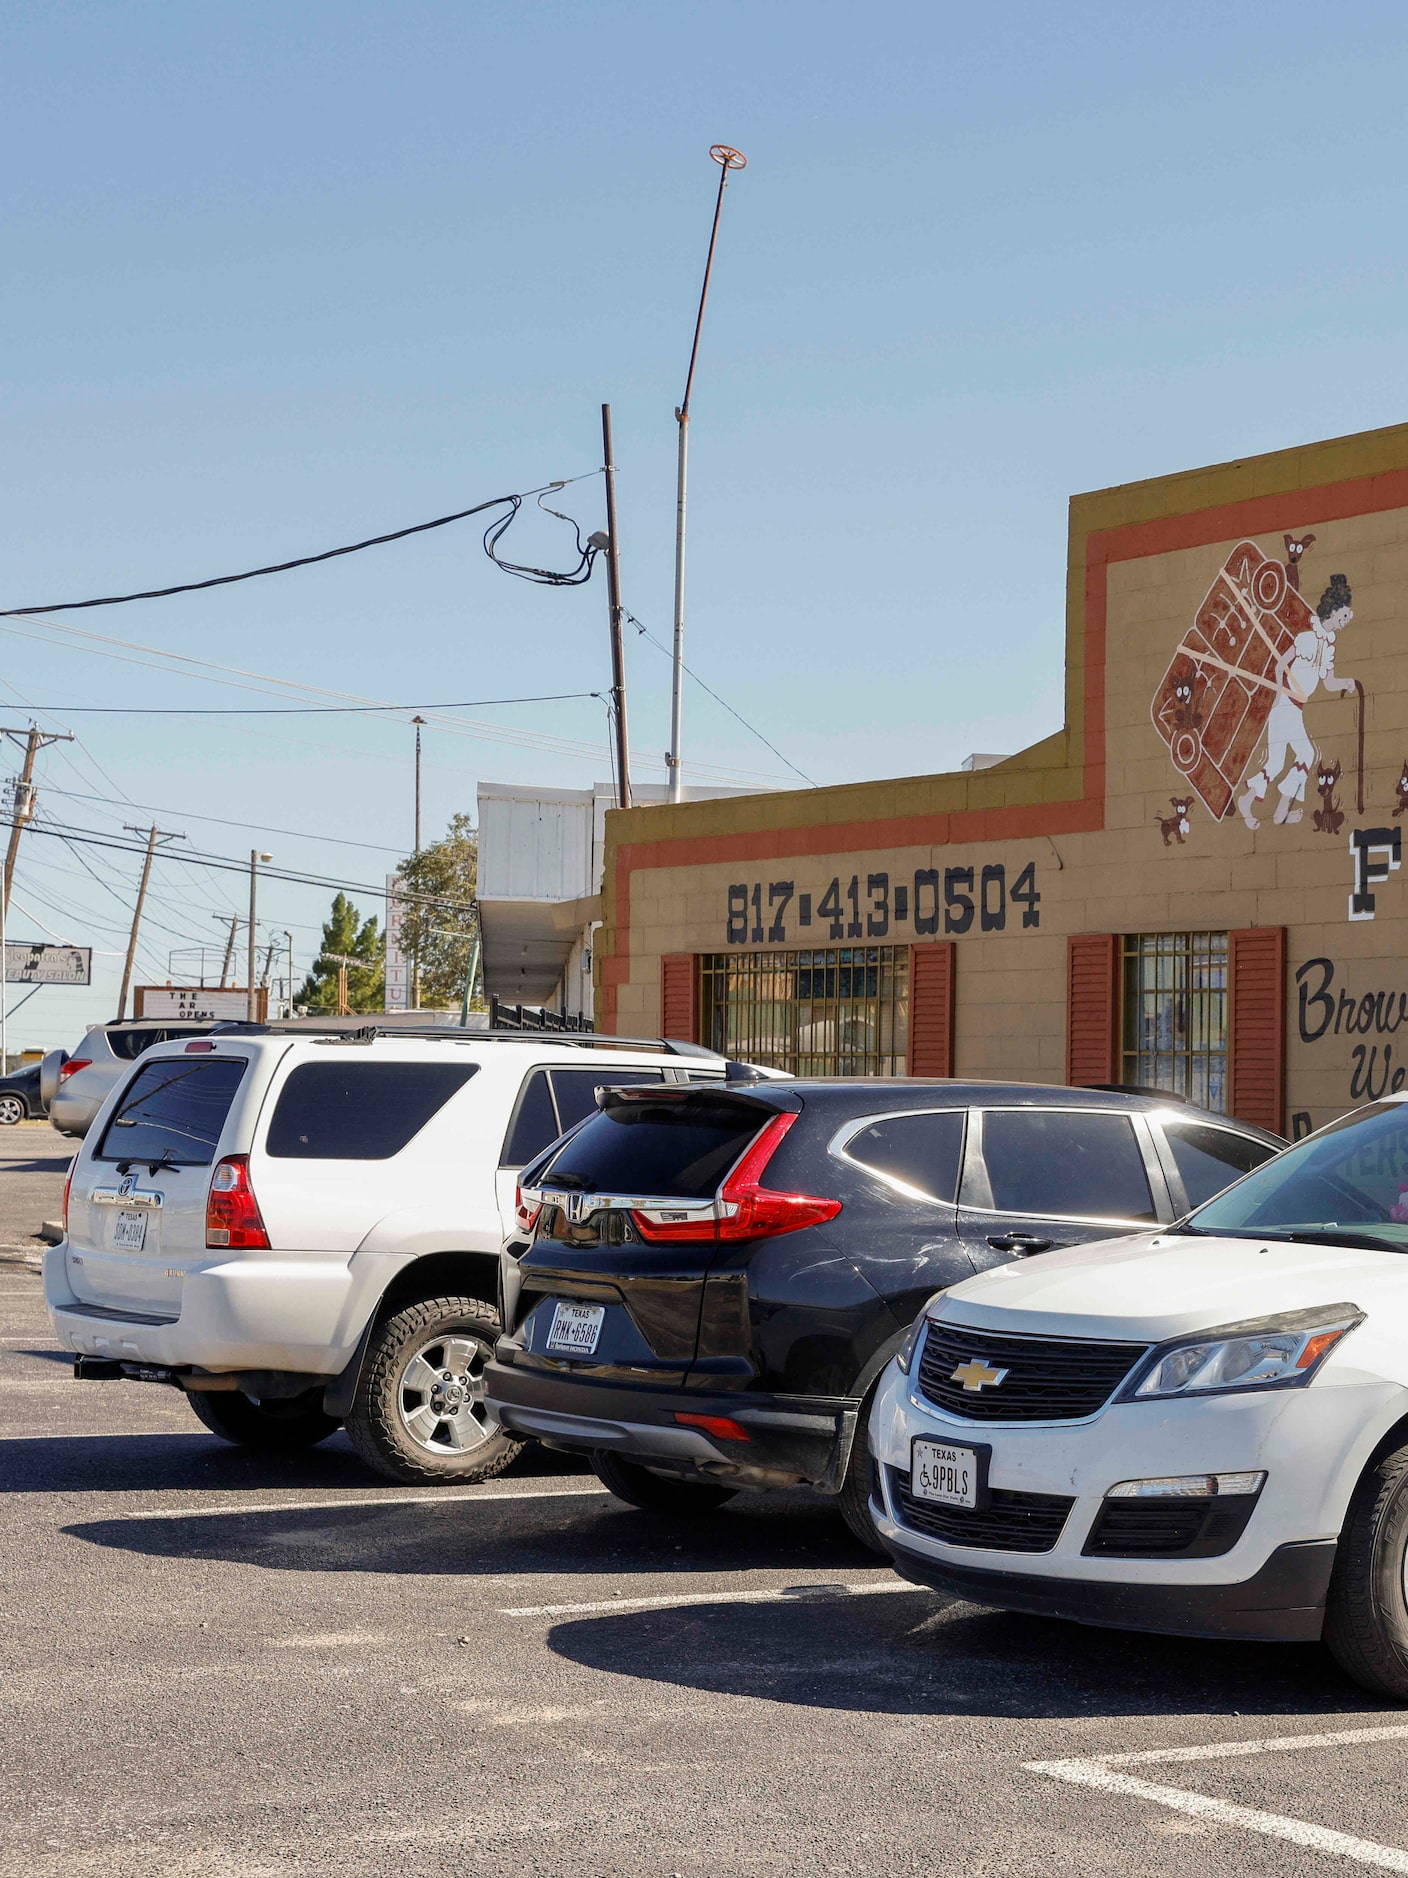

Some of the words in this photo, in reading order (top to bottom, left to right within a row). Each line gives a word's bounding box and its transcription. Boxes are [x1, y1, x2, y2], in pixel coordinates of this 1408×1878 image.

[5, 969, 44, 980] EAUTY
[46, 970, 86, 980] SALON
[169, 992, 198, 1000] THE
[180, 1011, 215, 1019] OPENS
[572, 1308, 590, 1319] TEXAS
[932, 1448, 957, 1462] TEXAS
[933, 1465, 968, 1495] 9PBLS
